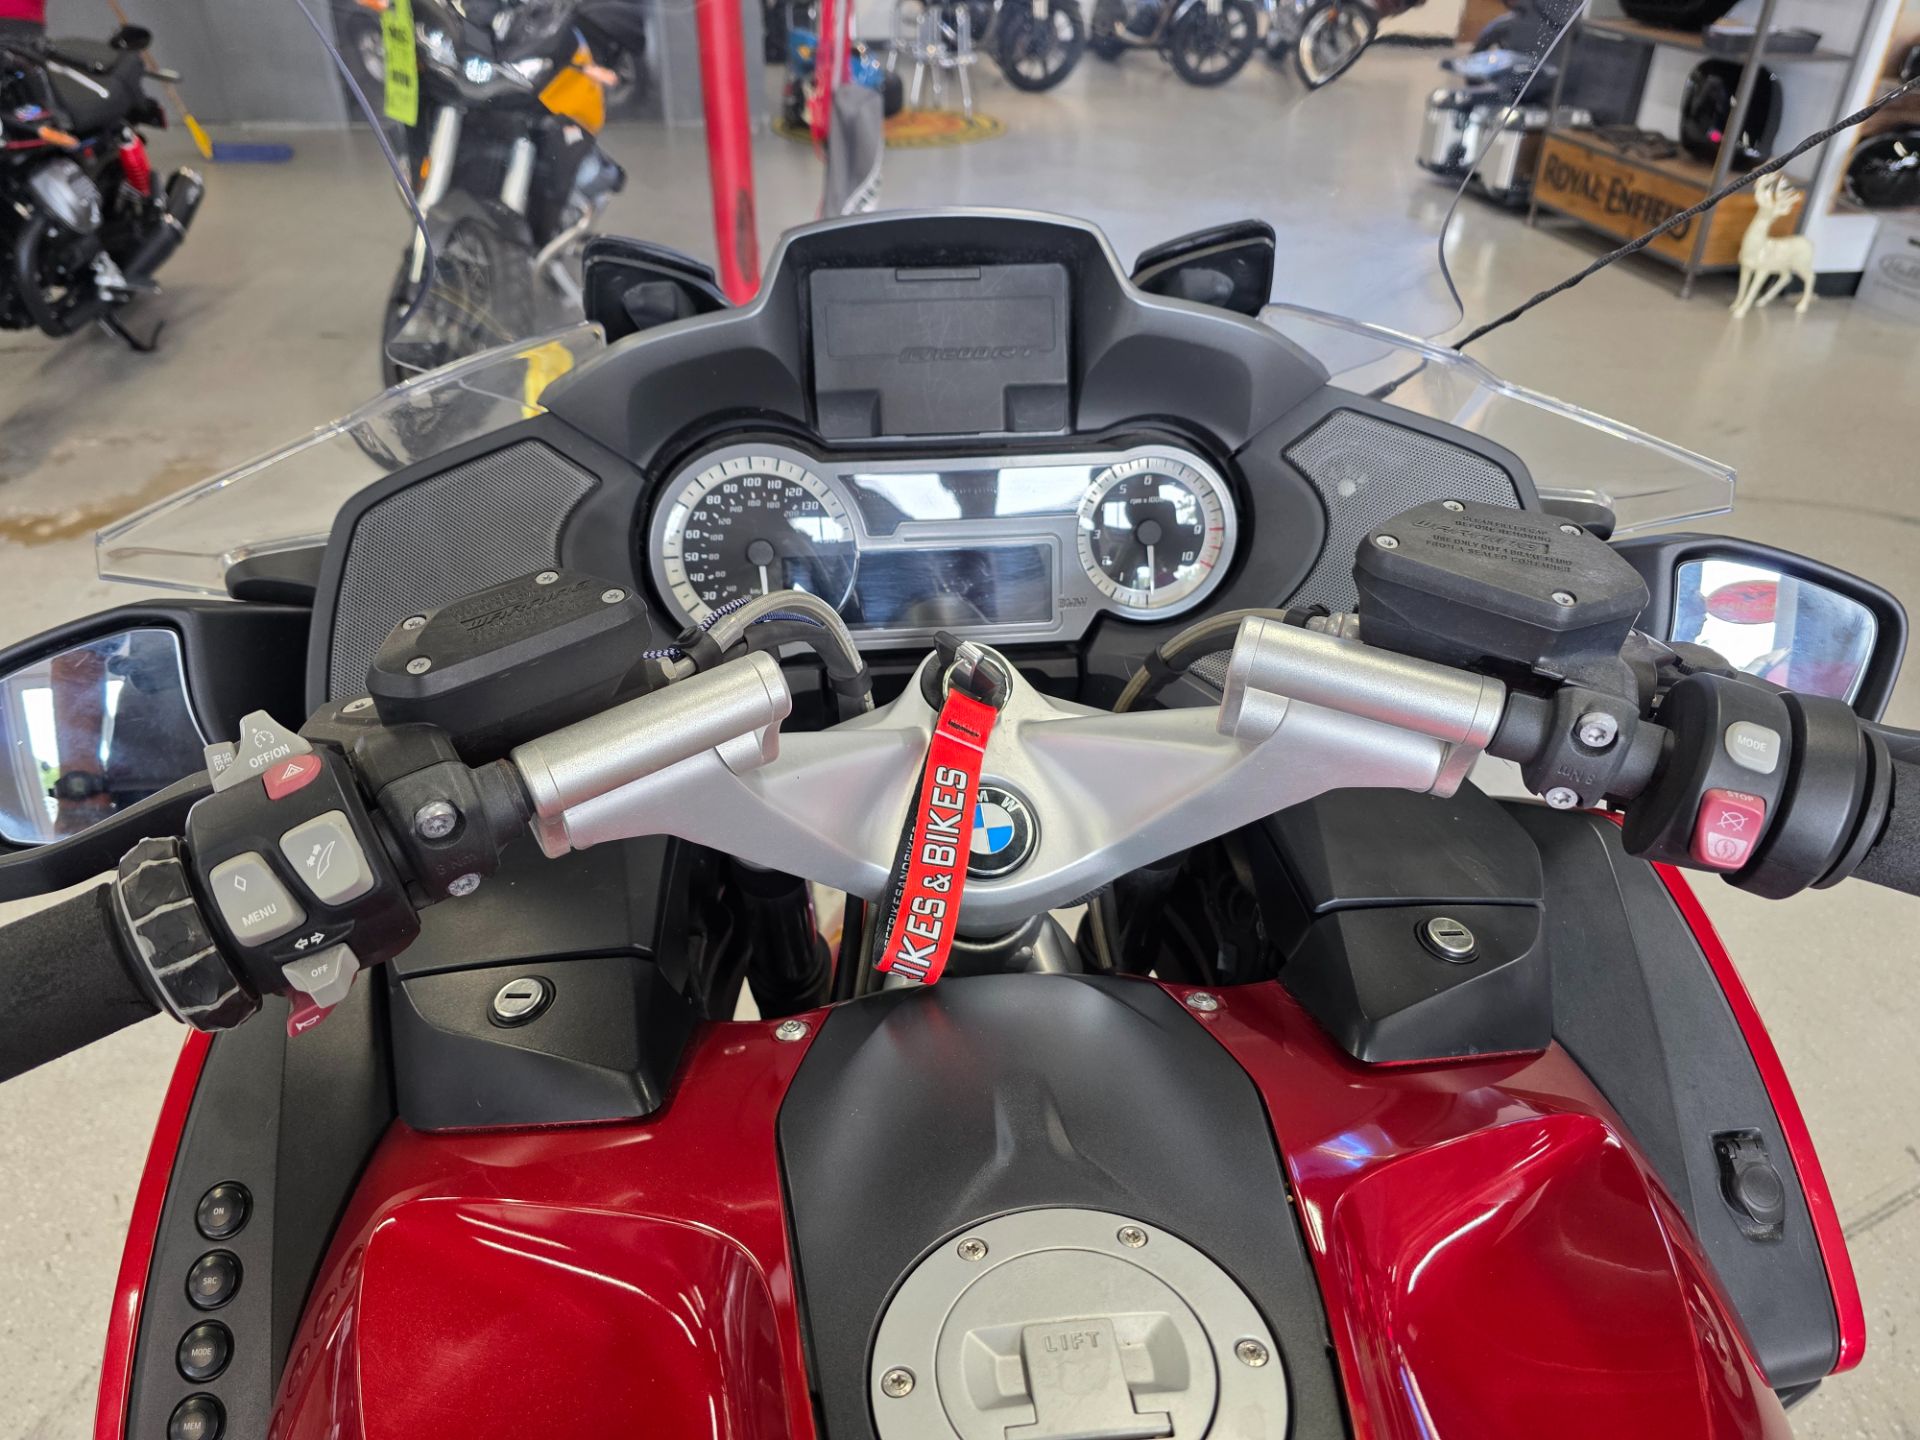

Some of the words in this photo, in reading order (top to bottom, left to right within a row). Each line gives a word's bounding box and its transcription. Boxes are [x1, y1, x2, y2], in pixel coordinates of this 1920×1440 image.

[742, 477, 762, 487] 100
[767, 480, 782, 489] 110
[723, 484, 738, 494] 90
[785, 486, 803, 497] 120
[1119, 484, 1128, 494] 5
[706, 495, 721, 505] 80
[802, 501, 819, 510] 130
[693, 511, 707, 521] 70
[685, 529, 700, 539] 60
[1093, 530, 1101, 540] 3
[684, 552, 699, 562] 50
[1181, 551, 1194, 561] 10
[690, 573, 705, 582] 40
[1119, 571, 1124, 581] 1
[702, 591, 717, 600] 30
[1736, 734, 1768, 753] MODE
[249, 743, 291, 769] OFF/ON
[212, 754, 225, 772] RES
[977, 790, 1020, 812] MW
[1726, 790, 1754, 802] STOP
[920, 765, 968, 868] BIKES
[922, 873, 953, 894] &
[241, 903, 278, 927] MENU
[888, 896, 948, 983] IKES
[311, 964, 329, 978] OFF
[213, 1207, 225, 1216] ON
[202, 1277, 218, 1286] SRC
[1044, 1330, 1100, 1353] LIFT
[191, 1347, 213, 1357] MODE
[183, 1421, 202, 1431] MEM
